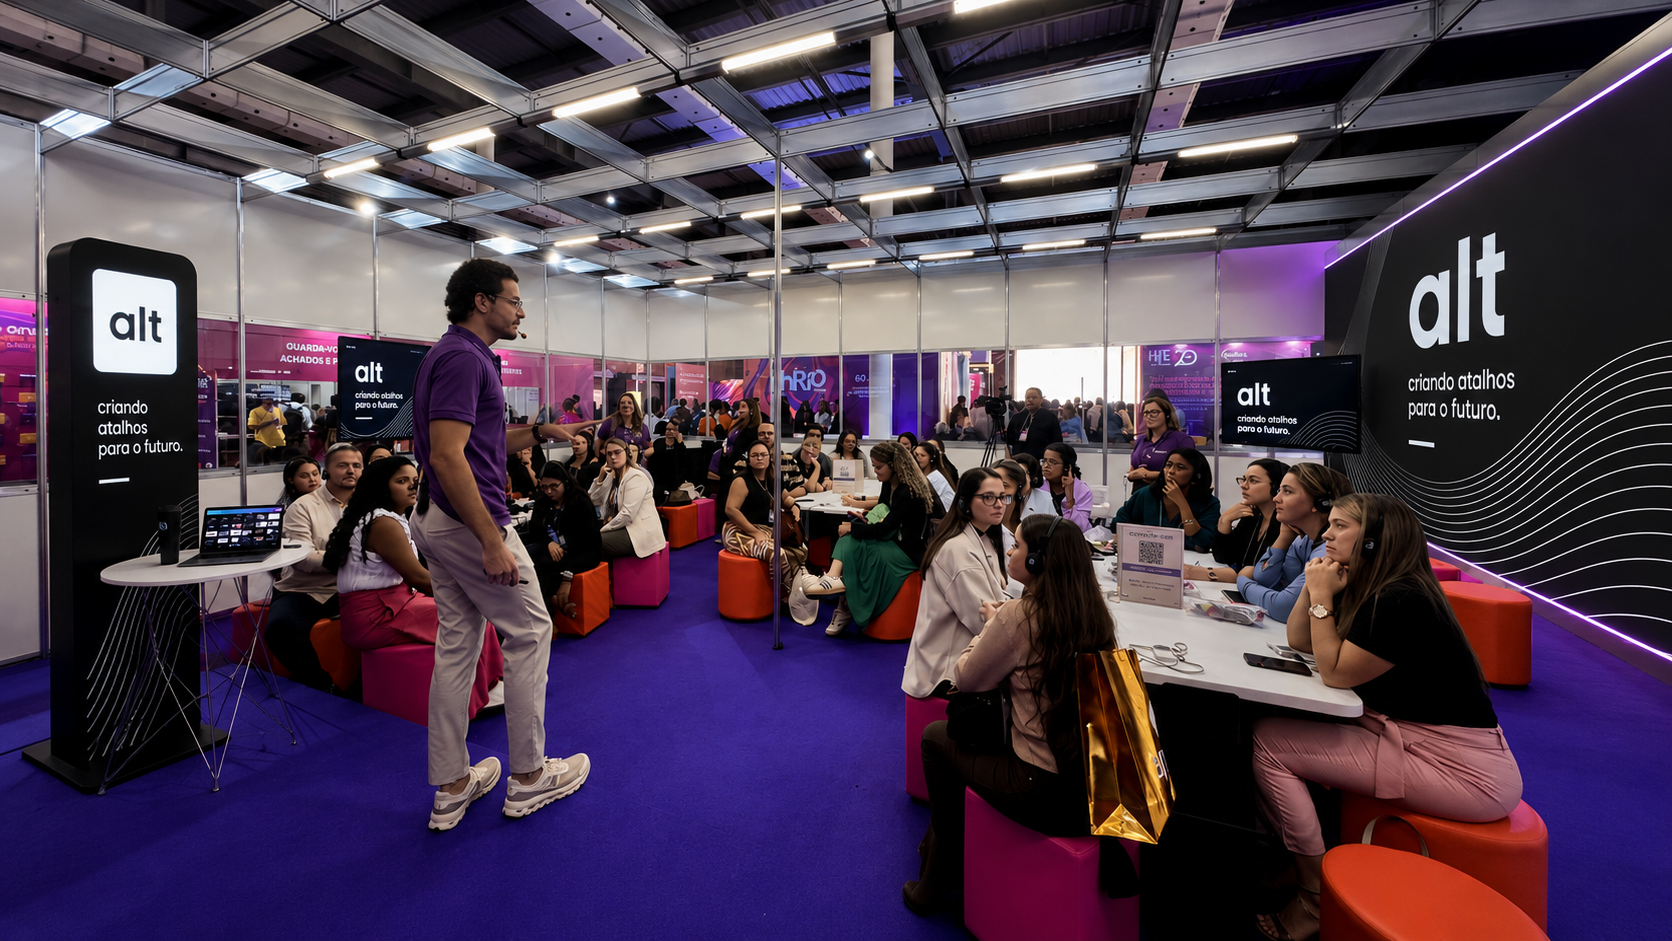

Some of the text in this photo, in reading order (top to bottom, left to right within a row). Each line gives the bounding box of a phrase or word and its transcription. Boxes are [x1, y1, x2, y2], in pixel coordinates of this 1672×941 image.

[1409, 231, 1506, 350] alt
[109, 306, 162, 344] alt
[279, 354, 324, 365] ACHADOS
[355, 361, 383, 384] alt
[1408, 368, 1515, 391] criando atalhos
[1237, 382, 1271, 406] alt
[97, 399, 149, 415] criando
[1408, 397, 1501, 421] para o futuro.
[97, 420, 148, 435] atalhos
[1237, 414, 1267, 424] criando
[1256, 425, 1263, 433] o
[98, 438, 184, 460] para o futuro.
